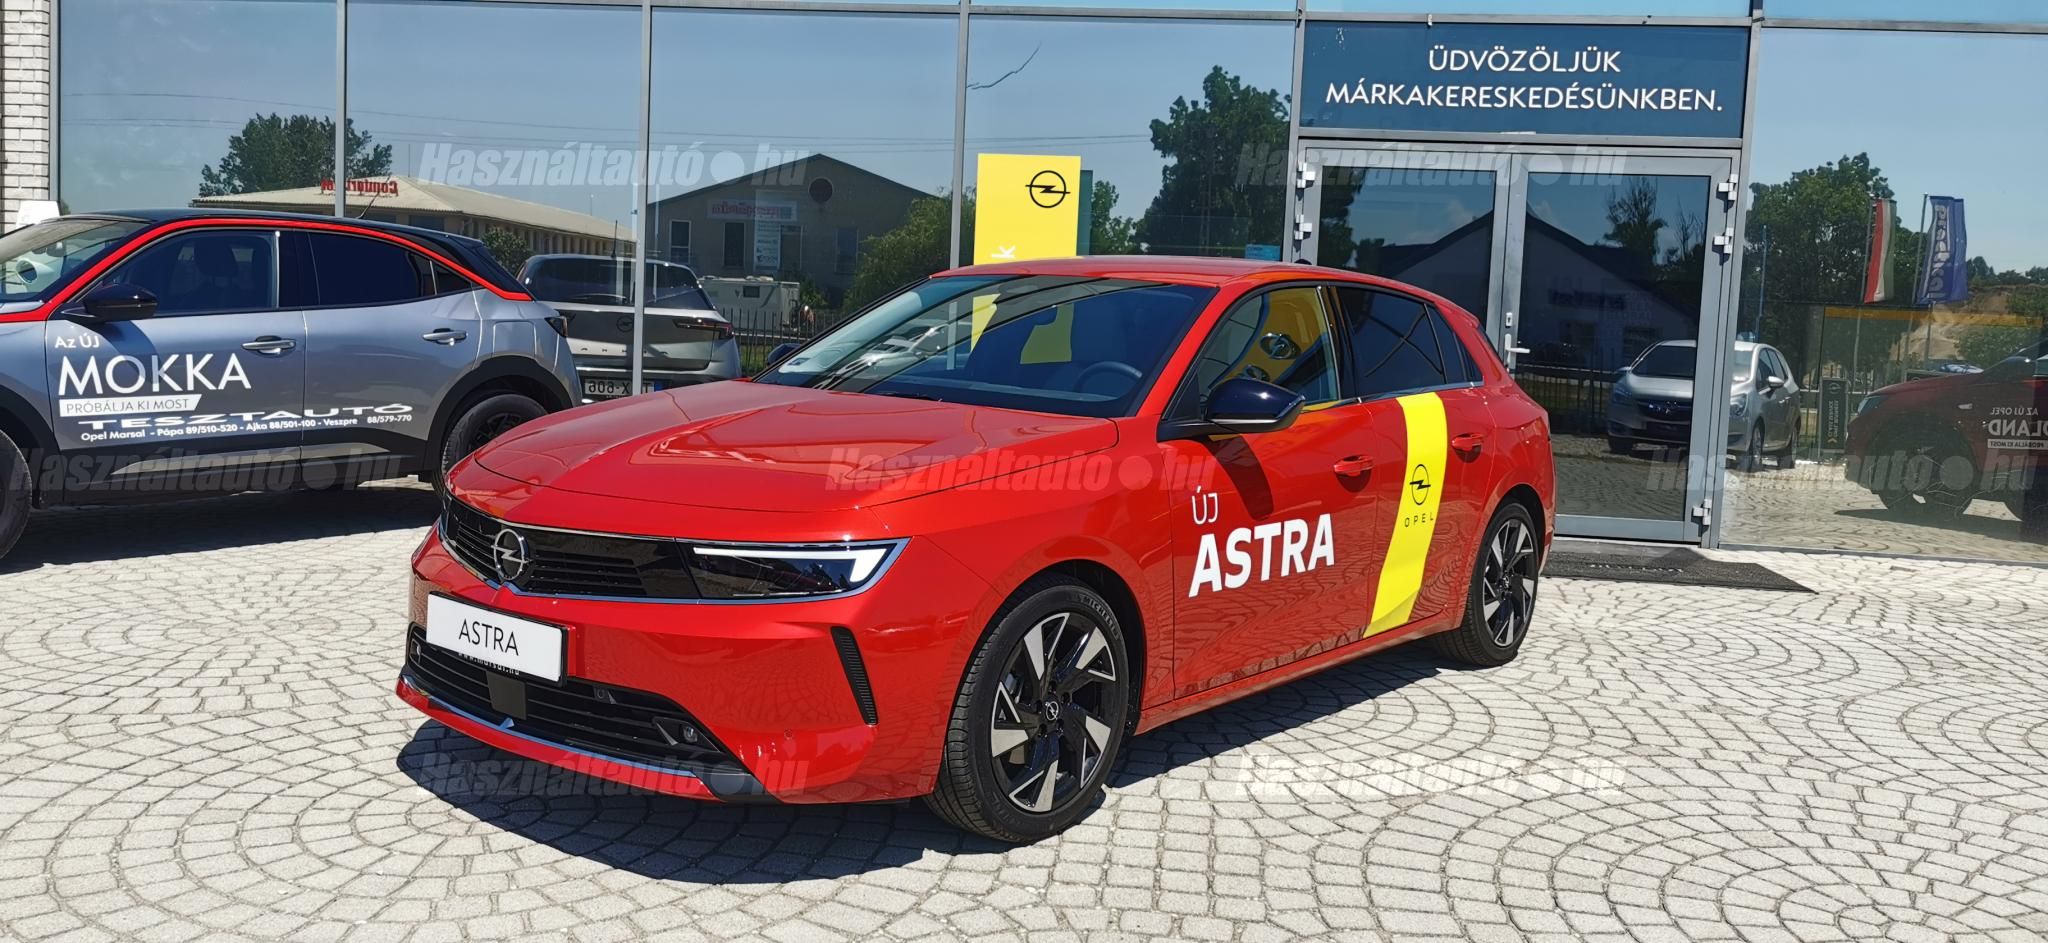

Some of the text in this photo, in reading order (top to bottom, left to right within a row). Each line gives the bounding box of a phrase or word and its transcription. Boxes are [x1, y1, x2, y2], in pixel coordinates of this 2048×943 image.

[1428, 45, 1621, 73] ÜDVÖZÖLJÜK
[1326, 78, 1723, 112] MÁRKAKERESKEDÉSÜNKBEN.
[55, 333, 100, 349] Az ÚJ
[58, 353, 252, 396] MOKKA
[66, 399, 189, 414] PRÓBÁLJA KI MOST
[78, 403, 413, 430] TESZTAUTÓ
[81, 431, 107, 442] Opel
[109, 429, 145, 440] Marsal
[157, 427, 184, 438] Pápa
[186, 424, 238, 435] 89/510-520
[246, 423, 267, 432] Ajka
[269, 419, 316, 430] 88/501-100
[323, 417, 358, 427] Veszpre
[367, 414, 413, 424] 88/579-770
[1192, 486, 1218, 525] ÚJ
[1404, 512, 1434, 528] OPEL
[1188, 513, 1335, 598] ASTRA
[459, 618, 519, 656] ASTRA
